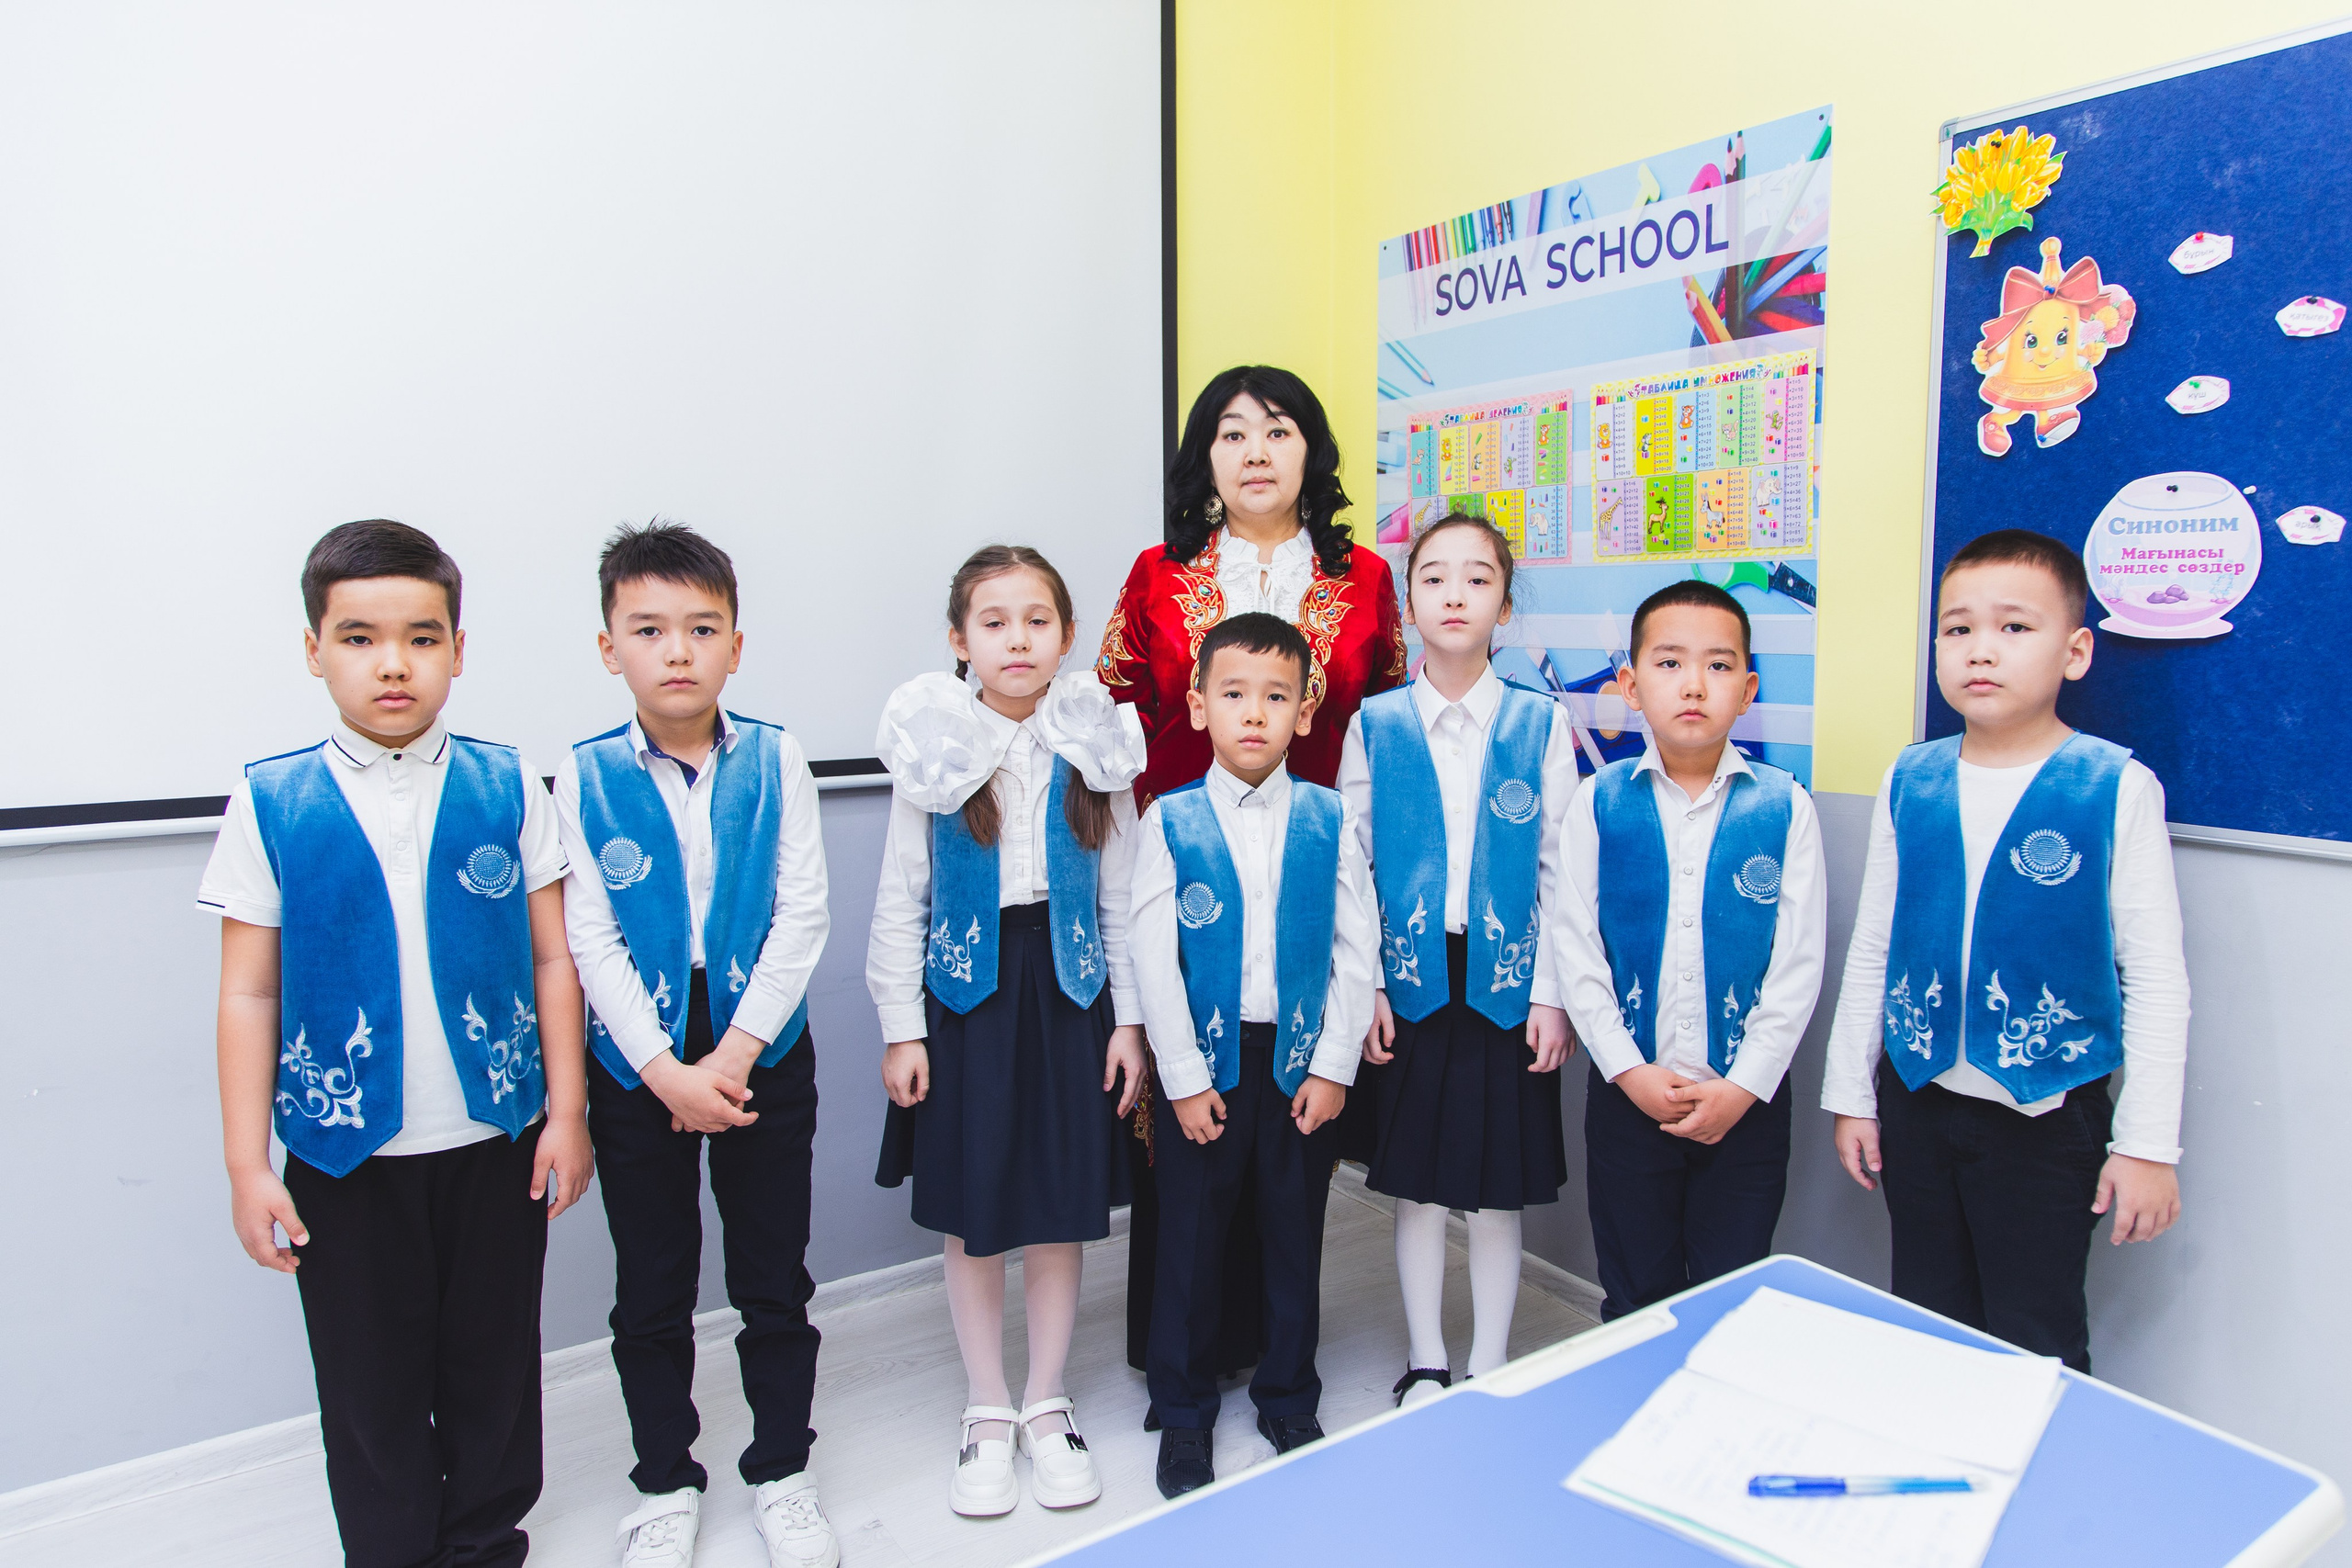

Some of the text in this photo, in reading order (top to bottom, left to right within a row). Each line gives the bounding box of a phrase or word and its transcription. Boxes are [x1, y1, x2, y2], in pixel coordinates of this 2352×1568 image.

[1435, 203, 1729, 316] SOVA SCHOOL
[1641, 367, 1757, 394] ТАБЛИЦА УМНОЖЕНИЯ
[2108, 516, 2239, 536] Синоним
[2120, 547, 2224, 560] Мағынасы
[2099, 562, 2245, 576] мәндес сөздер
